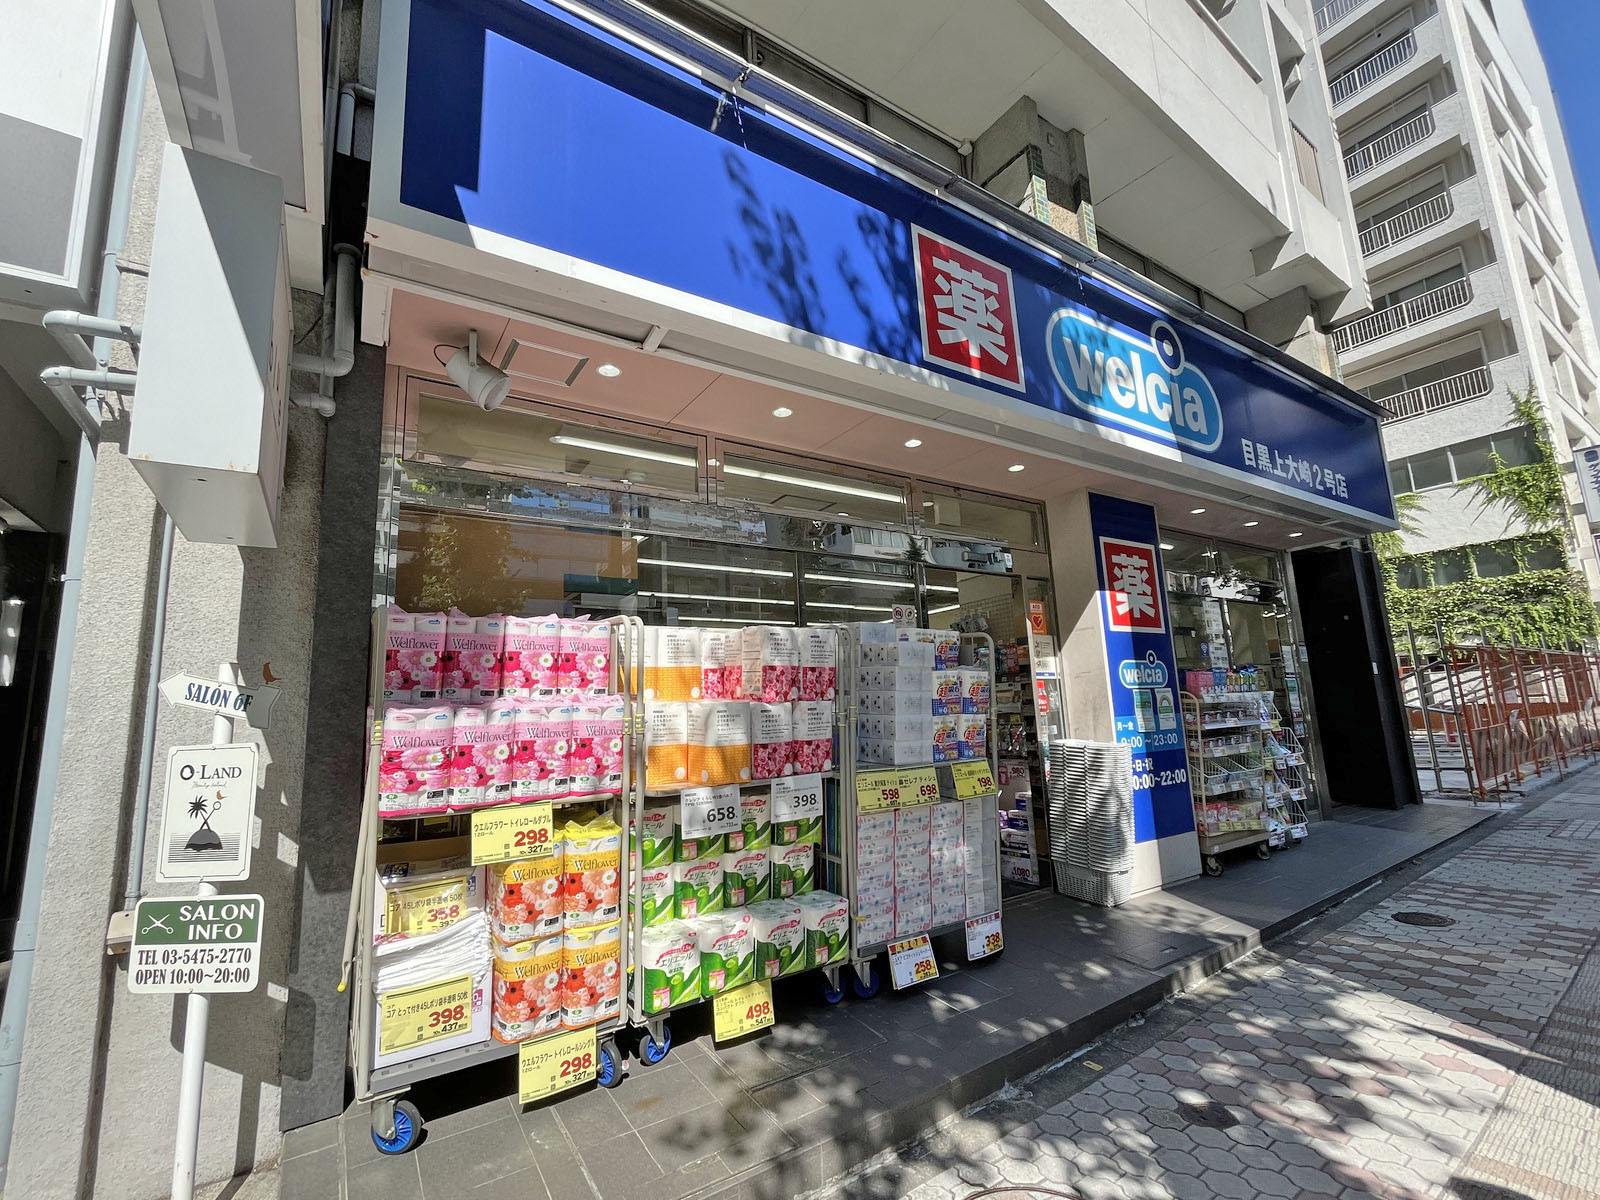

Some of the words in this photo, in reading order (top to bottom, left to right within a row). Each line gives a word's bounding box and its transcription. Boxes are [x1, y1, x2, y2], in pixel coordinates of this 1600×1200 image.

[932, 256, 1009, 366] 薬
[1064, 332, 1208, 435] welcia
[1241, 437, 1349, 499] 目黒上大崎2号店
[1111, 553, 1156, 618] 薬
[389, 637, 440, 650] Welflower
[452, 638, 498, 651] Welflower
[513, 638, 556, 651] Welflower
[569, 640, 608, 653] Welflower
[1123, 661, 1163, 684] welcia
[185, 682, 232, 708] SALON
[233, 693, 254, 712] 6F
[464, 730, 513, 743] Welflower
[527, 727, 571, 739] Welflower
[1154, 733, 1178, 746] 23:00
[393, 735, 447, 748] Welflower
[977, 776, 992, 788] 198
[1132, 768, 1187, 791] 0:00~22:00
[881, 788, 899, 800] 598
[920, 784, 937, 796] 698
[793, 793, 817, 808] 398
[707, 806, 735, 822] 658
[514, 828, 549, 847] 298
[527, 845, 543, 854] 327
[574, 857, 618, 871] Welflower
[512, 864, 560, 881] Welflower
[179, 903, 255, 921] SALON
[427, 904, 460, 922] 358
[188, 923, 243, 940] INFO
[985, 932, 1000, 947] 338
[138, 950, 158, 965] TEL
[162, 948, 251, 965] 03-5475-2770
[575, 950, 619, 966] Welflower
[514, 960, 561, 979] Welflower
[914, 960, 932, 974] 258
[135, 968, 167, 985] OPEN
[170, 967, 250, 984] 10:00~20:00
[386, 1009, 396, 1018] コア
[428, 1004, 465, 1028] 398
[746, 1001, 770, 1020] 498
[441, 1022, 458, 1032] 437
[755, 1016, 767, 1026] 547
[560, 1053, 593, 1078] 298
[572, 1070, 587, 1082] 327
